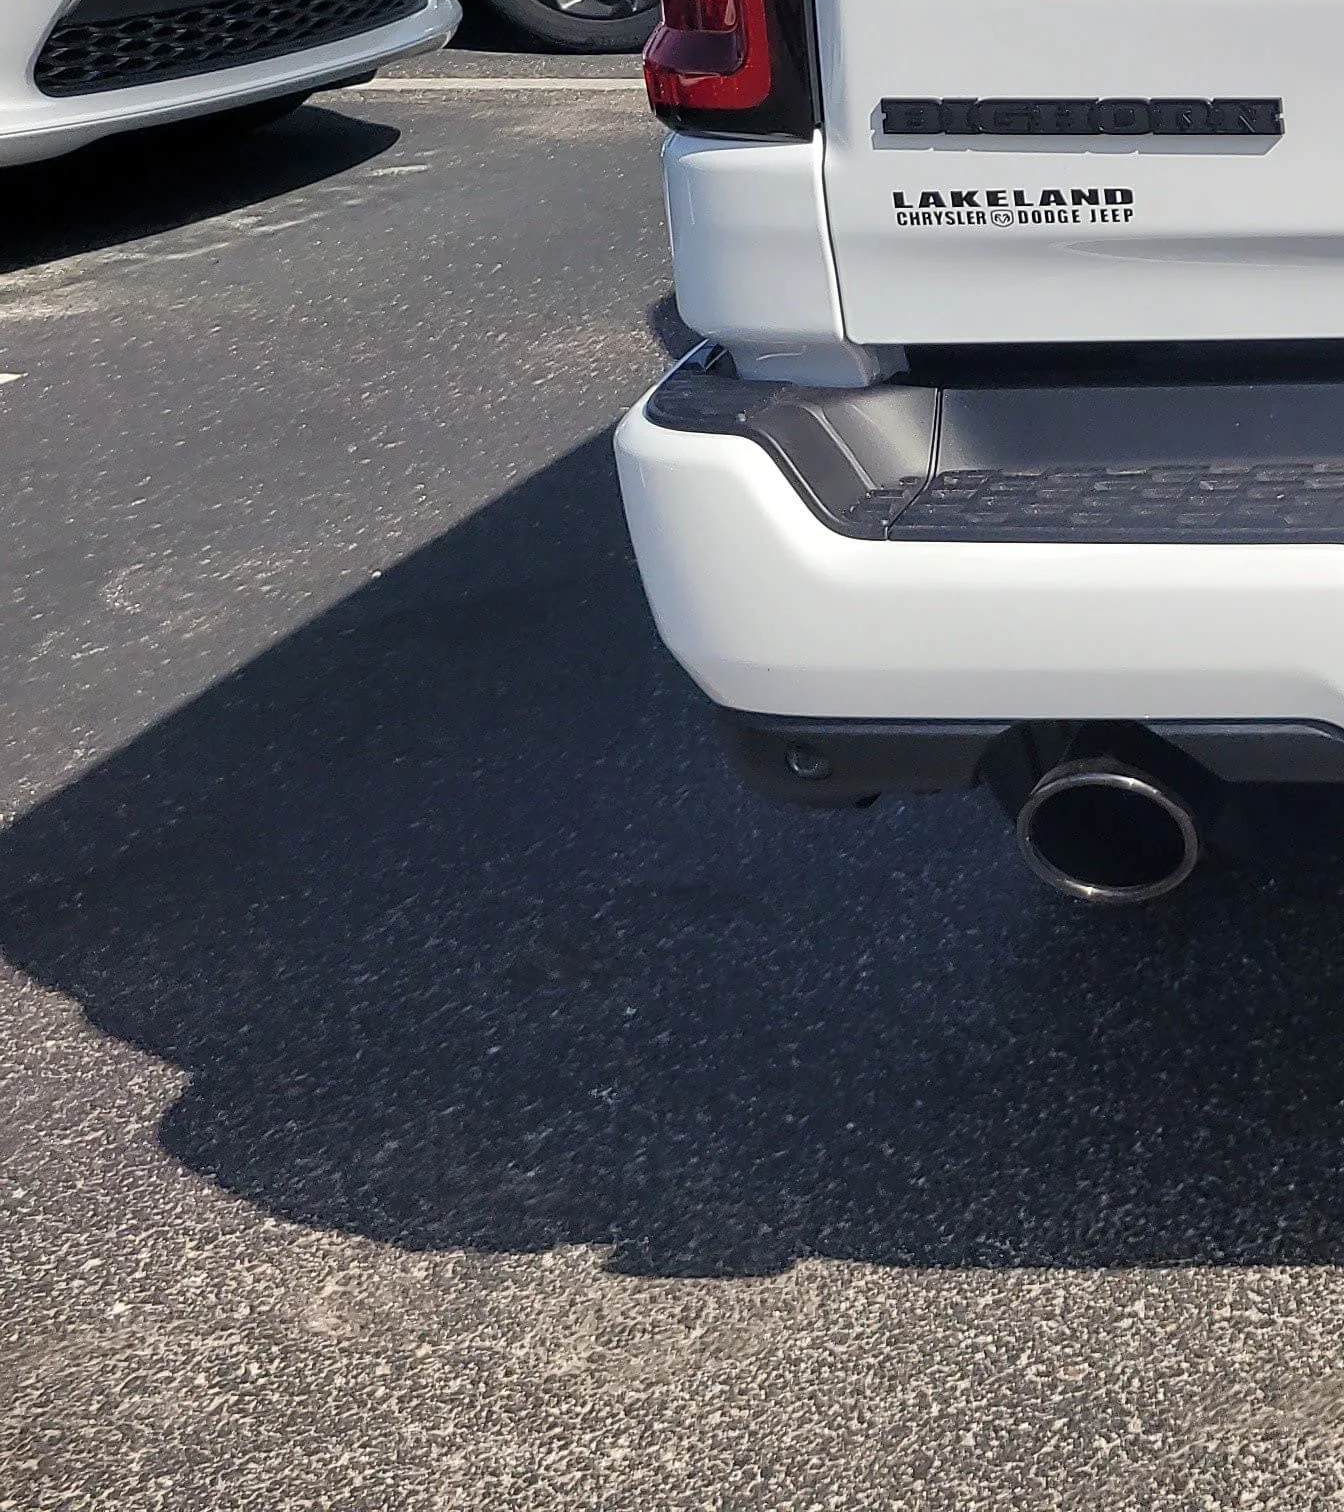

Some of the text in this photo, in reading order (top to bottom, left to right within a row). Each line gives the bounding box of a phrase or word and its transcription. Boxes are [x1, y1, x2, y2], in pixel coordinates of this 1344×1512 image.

[893, 189, 1133, 209] LAKELAND
[897, 208, 1133, 226] CHRYSLER DODGE JEEP
